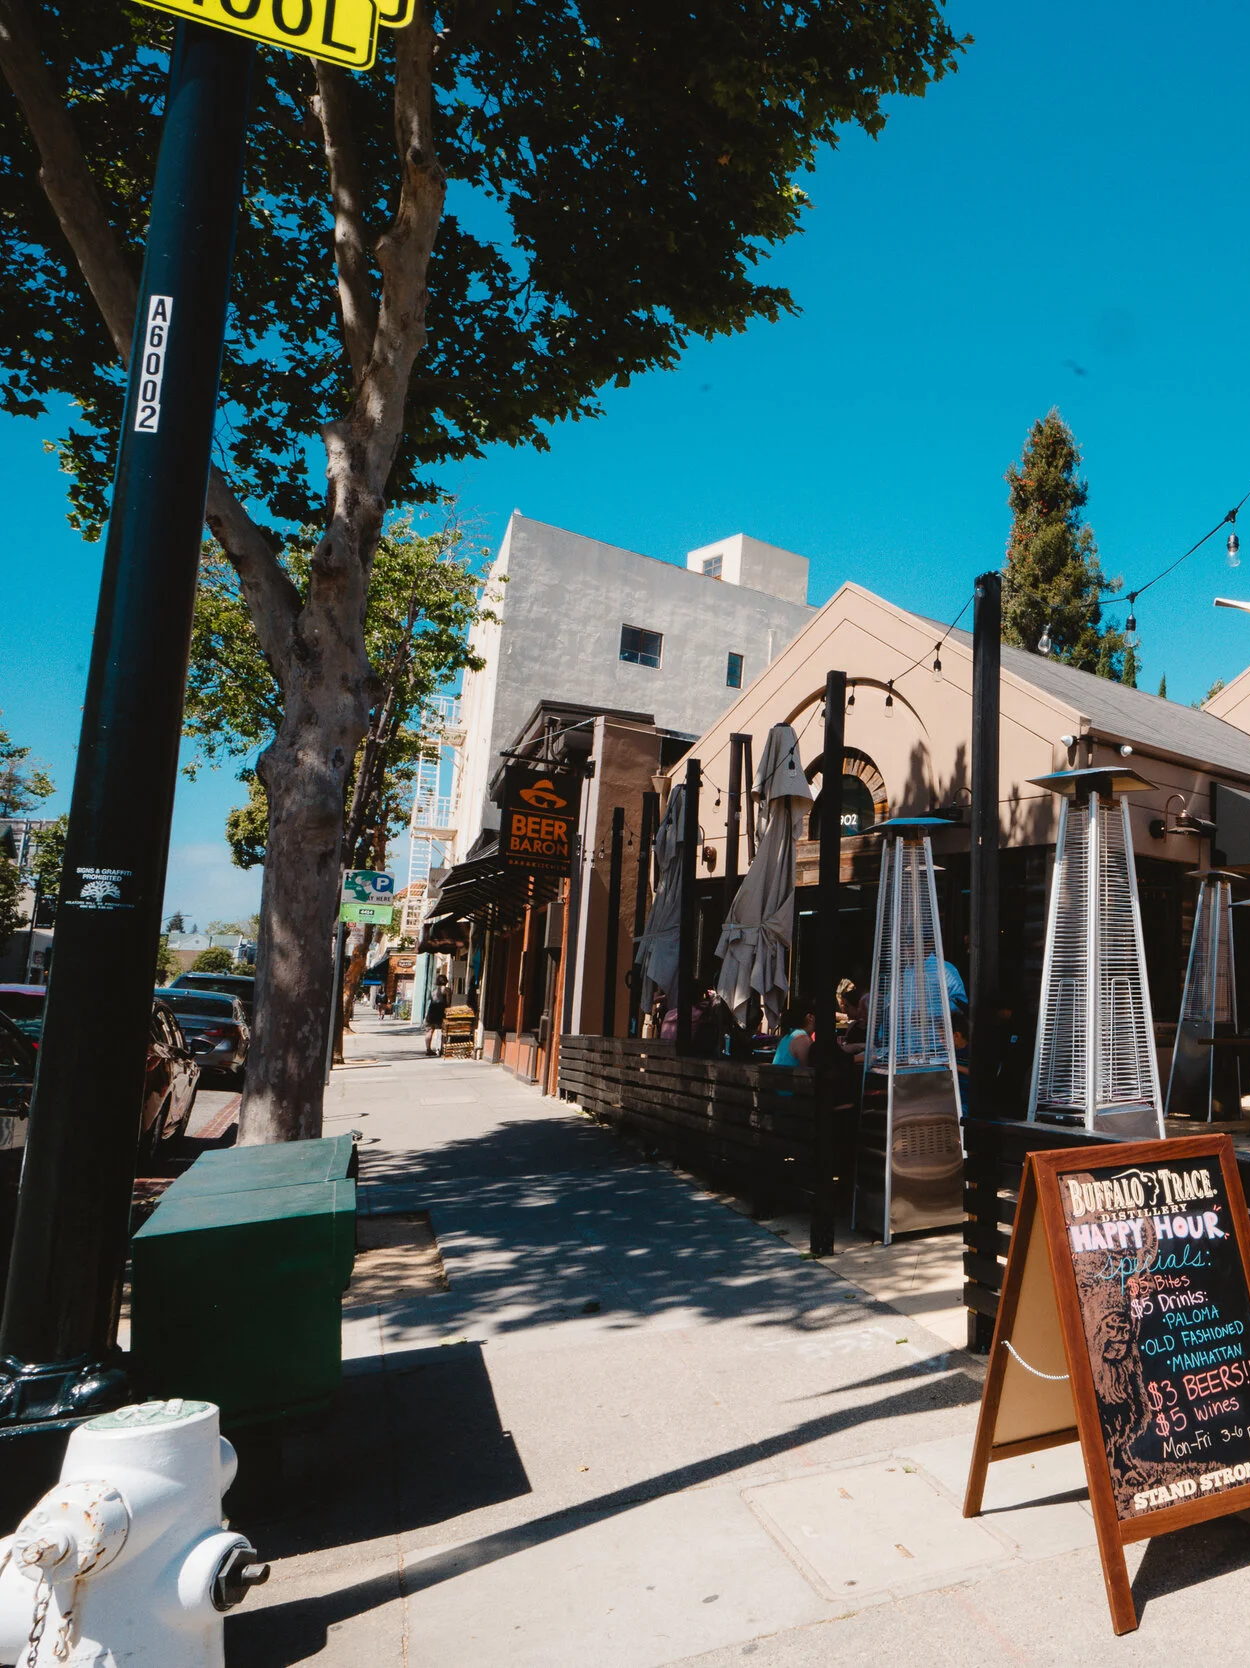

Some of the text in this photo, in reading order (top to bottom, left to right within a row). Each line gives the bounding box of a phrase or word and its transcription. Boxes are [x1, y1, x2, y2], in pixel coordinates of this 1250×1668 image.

[138, 298, 168, 430] A6002
[512, 814, 568, 842] BEER
[510, 836, 568, 857] BARON
[82, 874, 122, 882] PROHIBITED
[101, 868, 133, 876] GRAFFITI
[376, 877, 389, 890] P
[1067, 1176, 1145, 1218] BUFFALO
[1101, 1203, 1188, 1222] DISTILLERY
[1070, 1211, 1225, 1253] HAPPY HOUR
[1128, 1274, 1190, 1296] $5 Bites
[1131, 1290, 1209, 1319] $5 Drinks:
[1165, 1305, 1219, 1330] PALOMA
[1145, 1320, 1244, 1356] OLD FASHIONED
[1172, 1343, 1243, 1372] MANHATTAN
[1148, 1380, 1178, 1411] $3
[1155, 1406, 1187, 1437] $5
[1133, 1478, 1197, 1511] STAND
